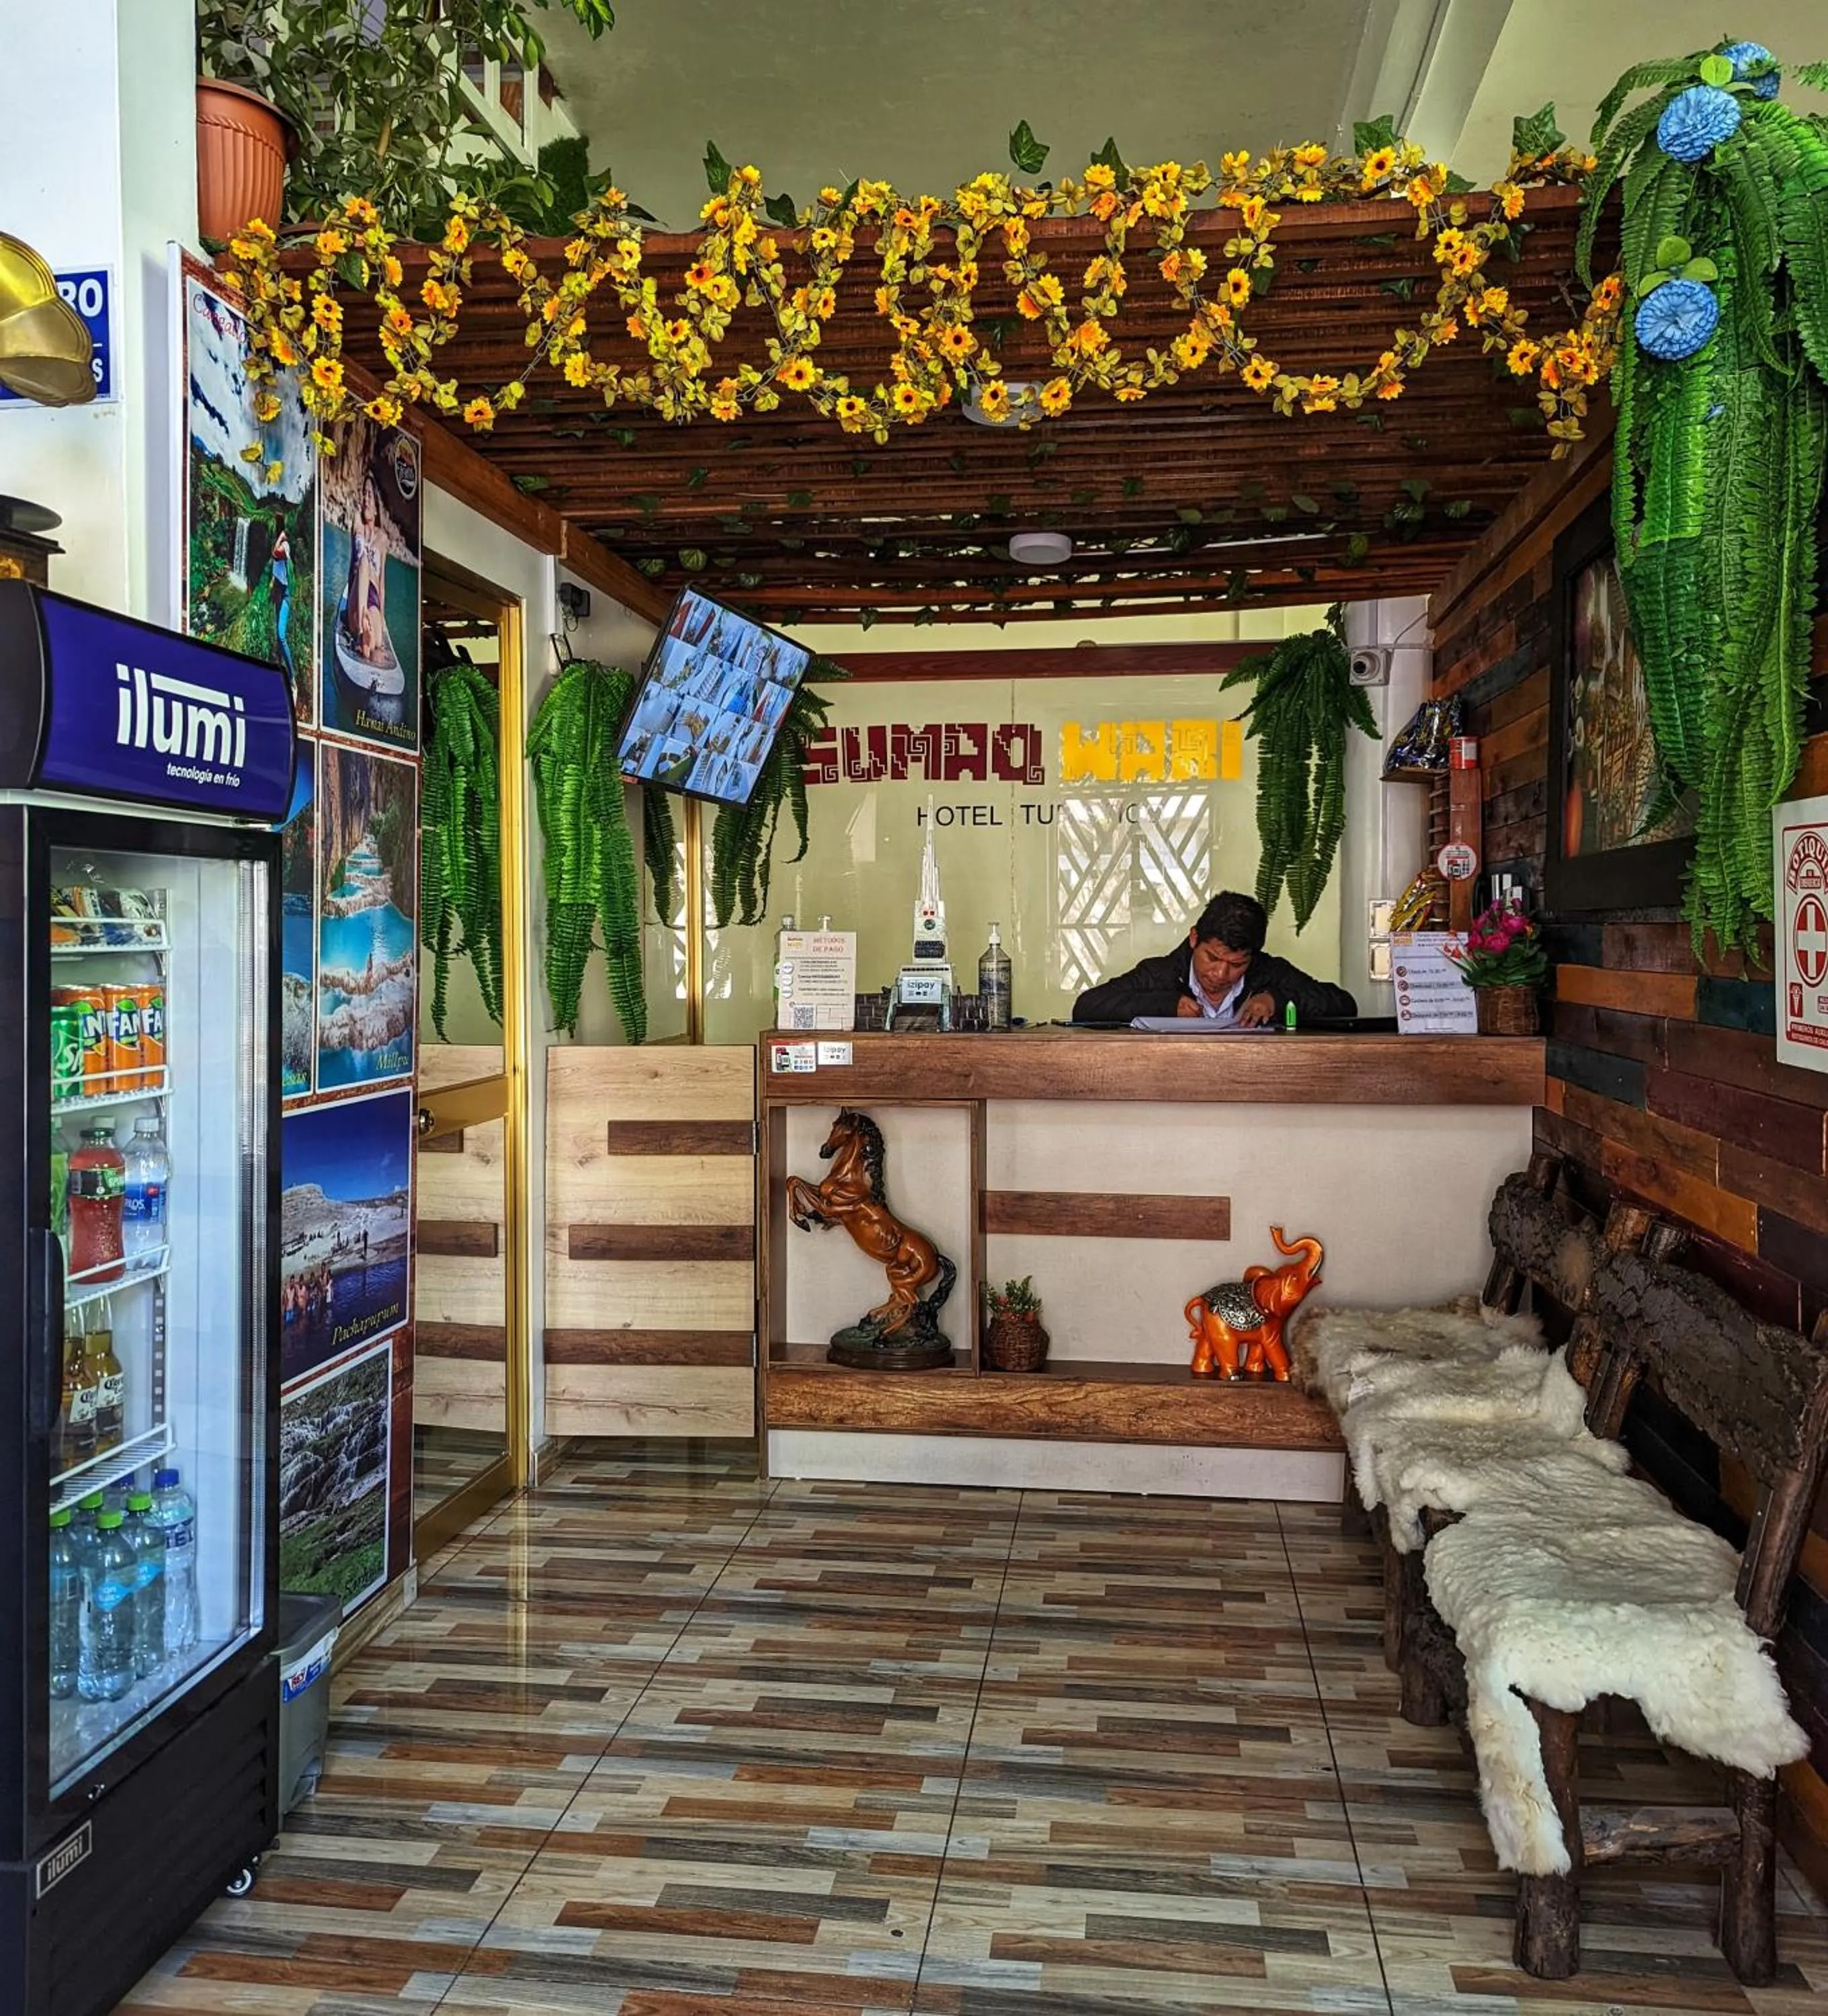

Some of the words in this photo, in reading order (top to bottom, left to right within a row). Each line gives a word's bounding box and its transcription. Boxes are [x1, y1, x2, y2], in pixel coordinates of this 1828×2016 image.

[116, 663, 246, 768] ilumi
[167, 762, 212, 784] tecnología
[213, 773, 224, 784] en
[225, 772, 241, 788] frío
[804, 723, 1045, 785] SUMAQ
[917, 805, 1003, 827] HOTEL
[48, 1835, 83, 1882] ilumi
